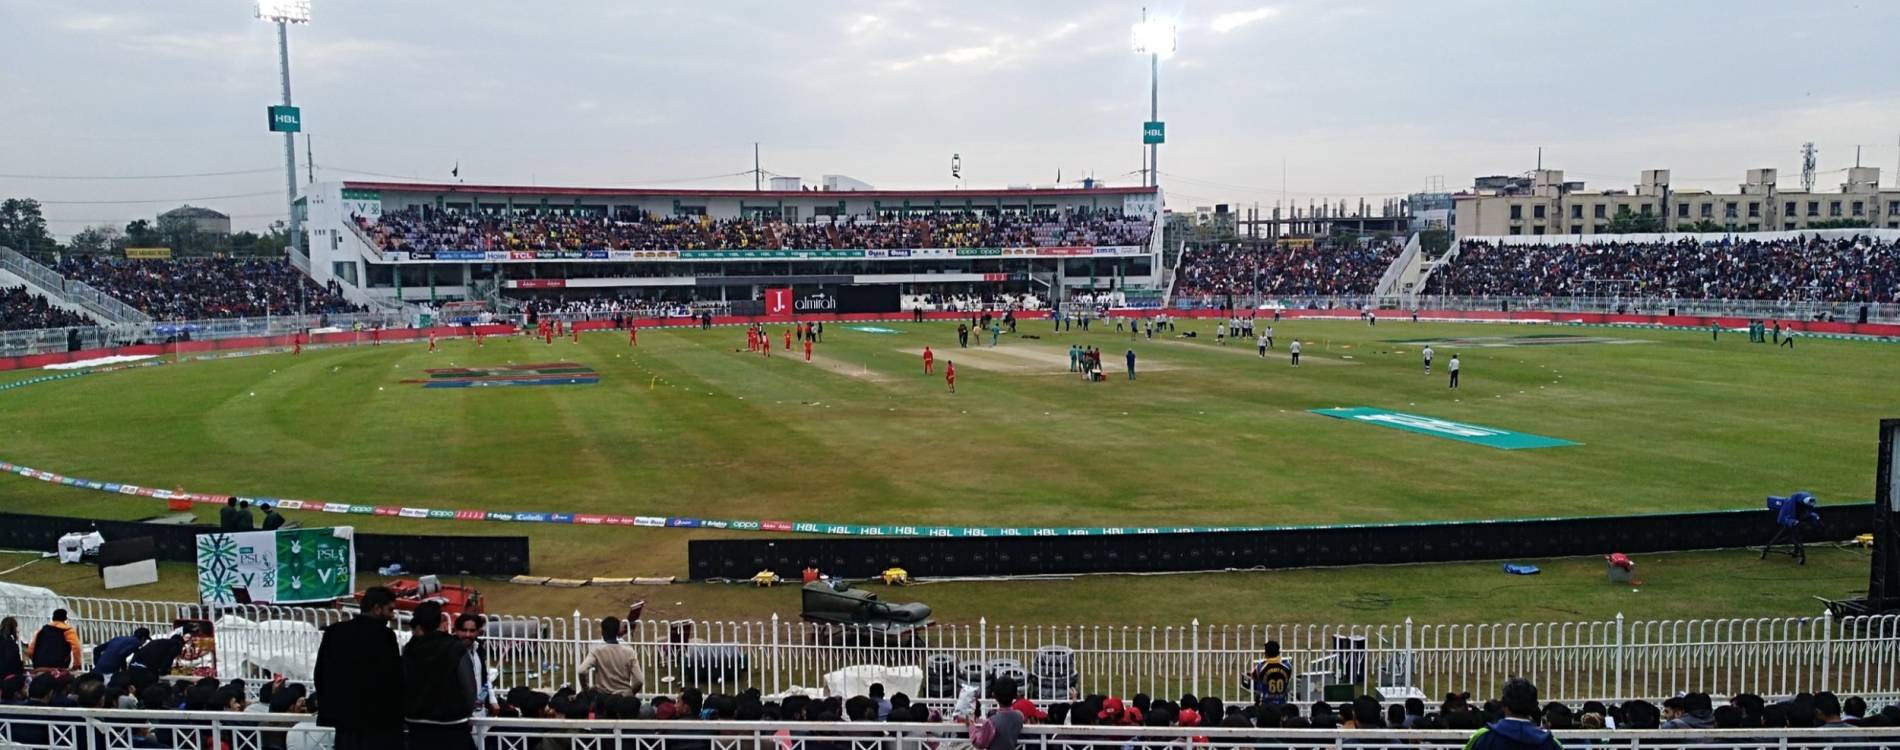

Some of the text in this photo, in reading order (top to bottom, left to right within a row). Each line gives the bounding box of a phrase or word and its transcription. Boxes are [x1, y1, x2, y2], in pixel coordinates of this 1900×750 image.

[275, 114, 299, 124] HBL
[1144, 129, 1163, 137] HBL
[357, 202, 367, 213] V
[794, 296, 836, 310] almirah
[732, 521, 759, 529] oppo
[796, 523, 820, 532] HBL
[828, 526, 852, 534] HBL
[860, 527, 885, 535] HBL
[895, 526, 919, 535] HBL
[929, 528, 954, 537] HBL
[963, 527, 988, 537] HBL
[1000, 528, 1022, 536] HBL
[1033, 528, 1059, 537] HBL
[241, 572, 255, 588] V
[317, 567, 332, 585] V
[1268, 679, 1285, 694] 60
